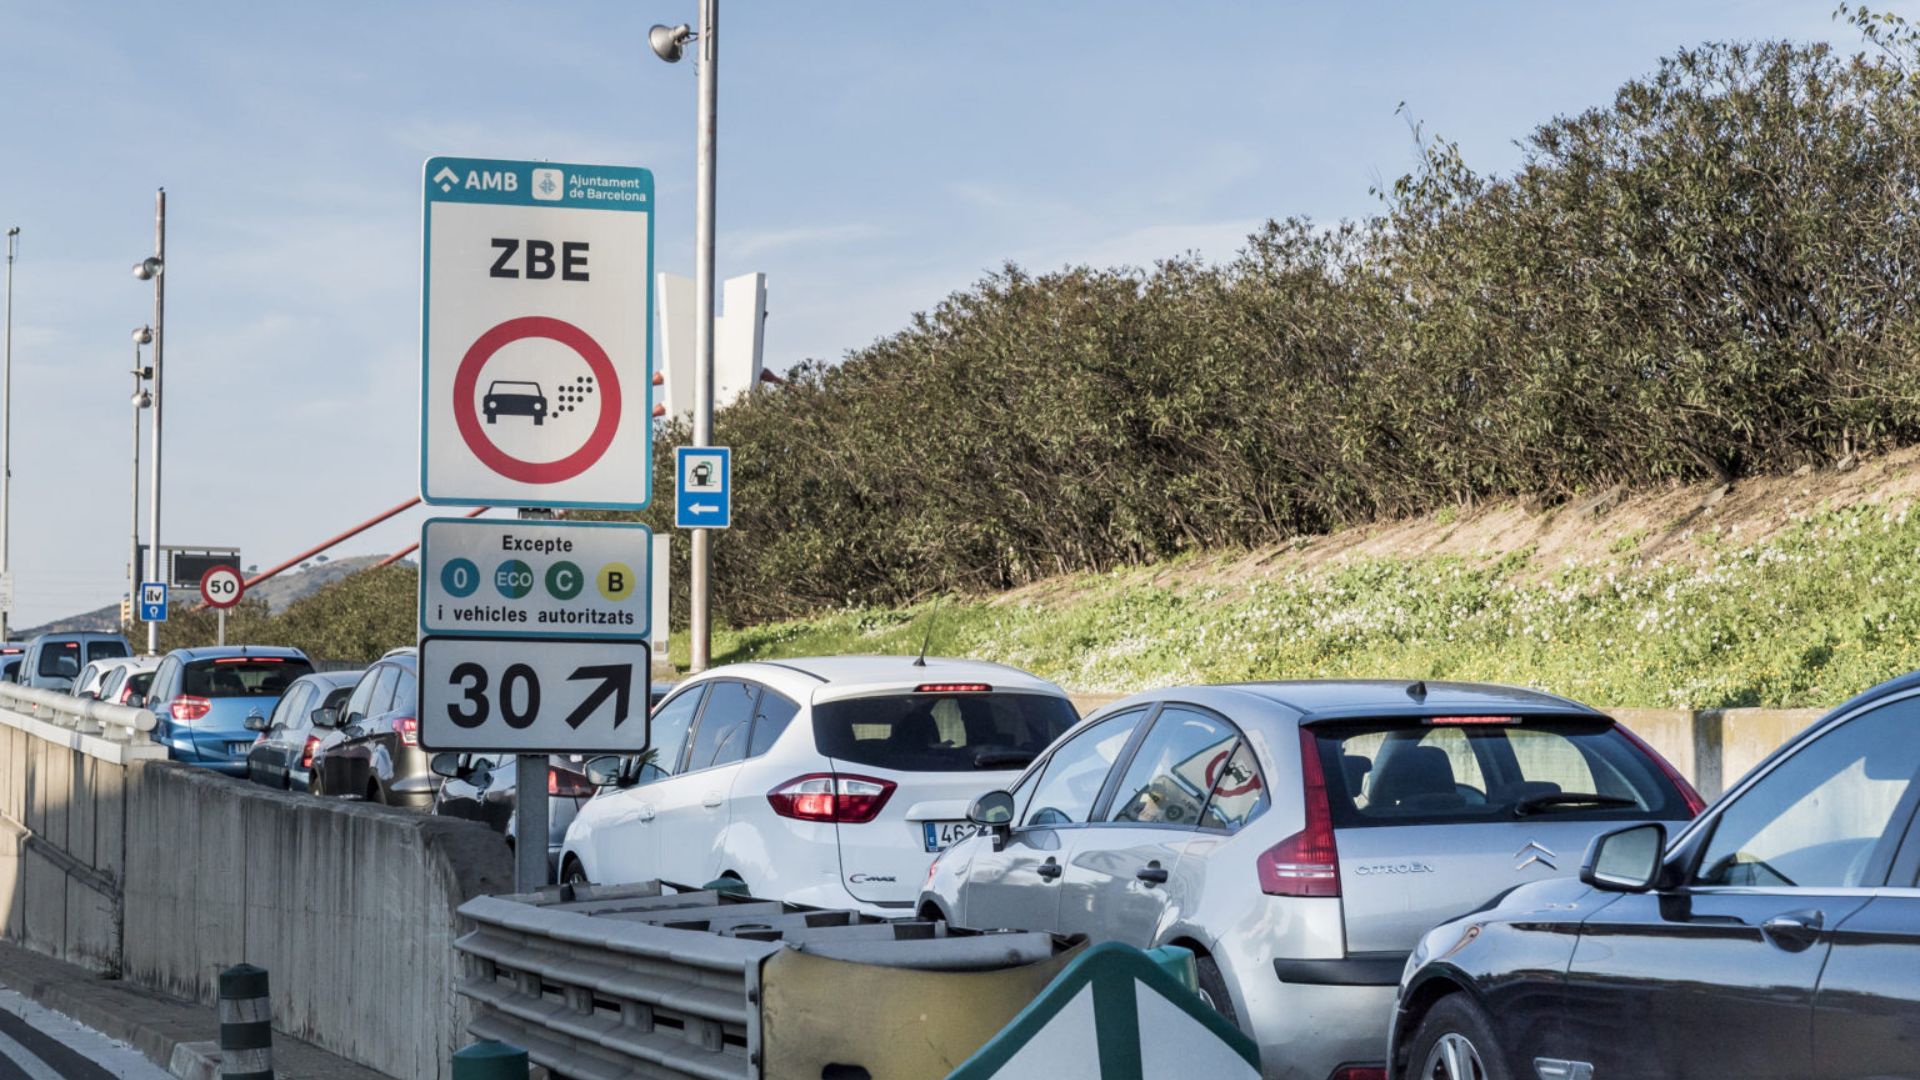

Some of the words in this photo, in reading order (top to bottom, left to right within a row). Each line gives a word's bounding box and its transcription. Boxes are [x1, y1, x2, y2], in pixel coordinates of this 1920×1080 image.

[465, 170, 519, 192] AMB
[569, 174, 640, 189] Ajuntament
[569, 188, 585, 199] de
[587, 188, 647, 202] Barcelona
[489, 237, 590, 282] ZBE
[502, 534, 573, 555] Excepte
[211, 580, 236, 594] 50
[453, 567, 468, 589] 0
[496, 571, 533, 588] ECO
[555, 570, 574, 592] C
[607, 571, 624, 592] B
[438, 605, 443, 621] i
[454, 606, 527, 622] vehicles
[538, 609, 634, 625] autoritzats
[447, 662, 541, 729] 30
